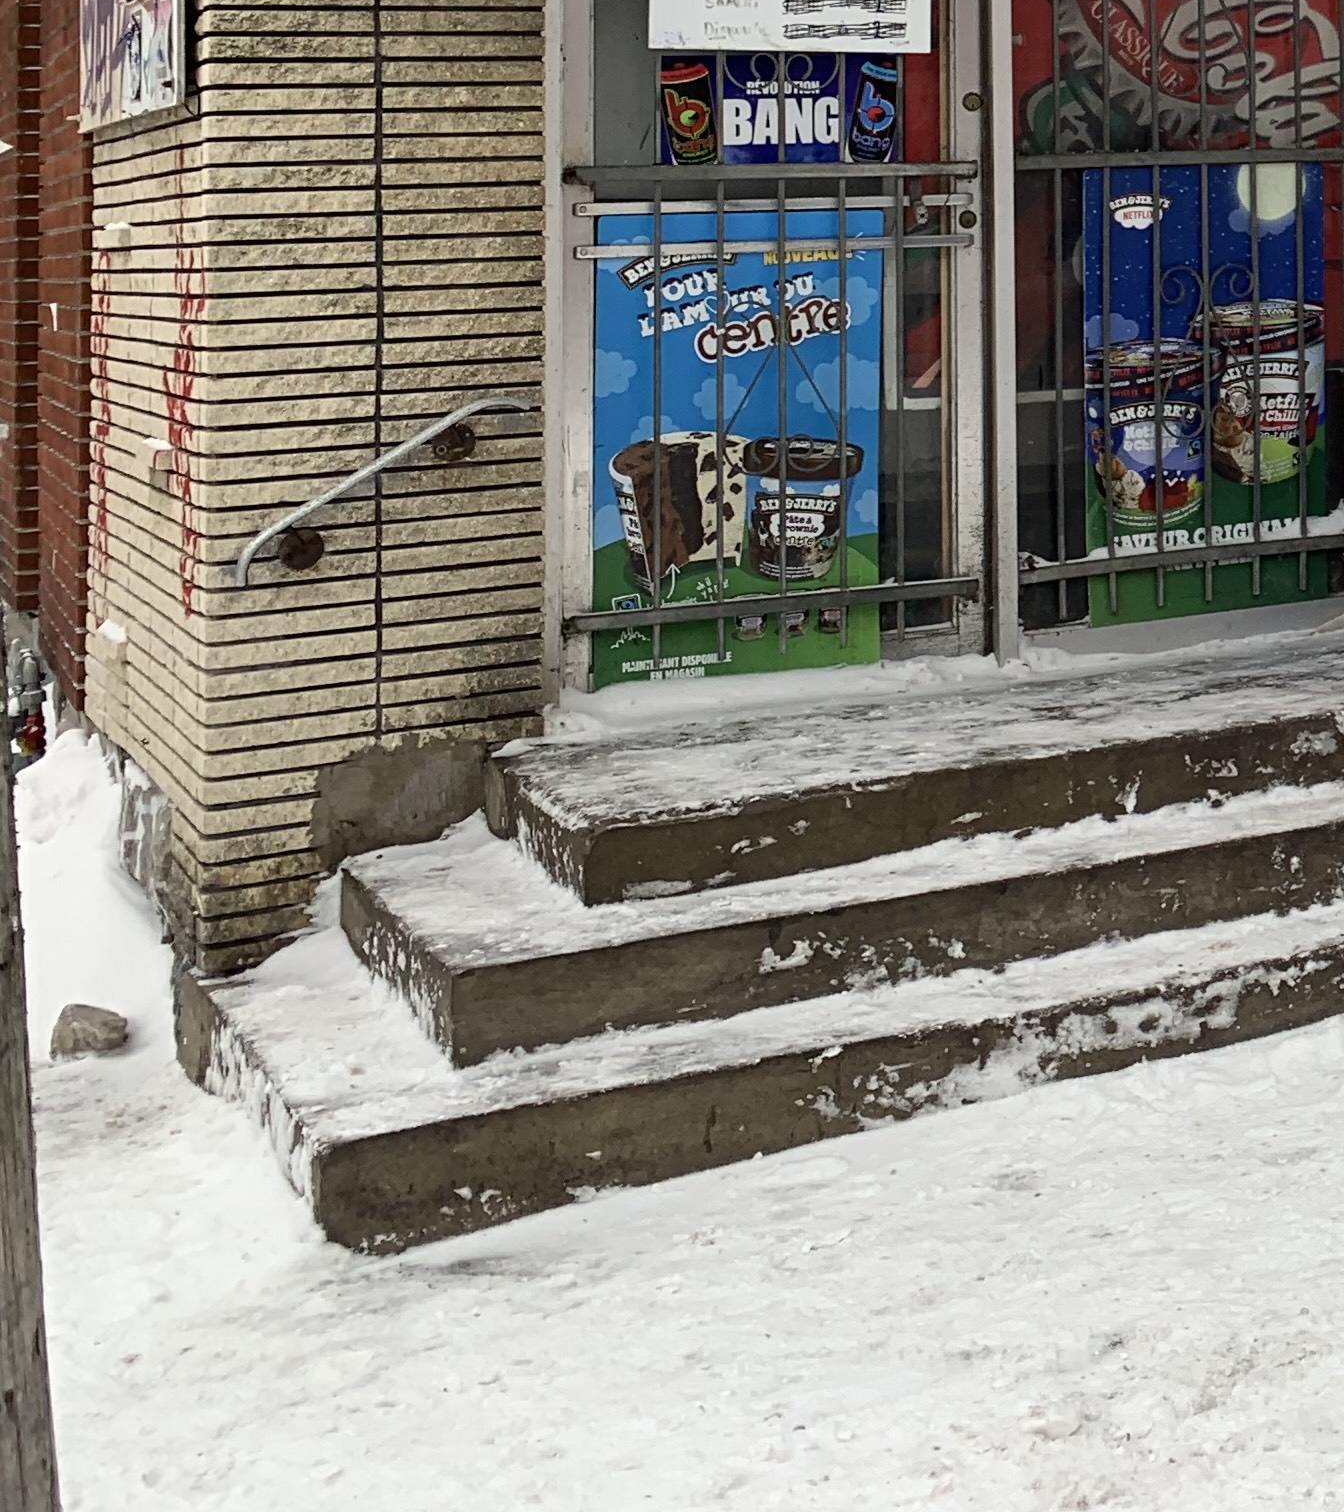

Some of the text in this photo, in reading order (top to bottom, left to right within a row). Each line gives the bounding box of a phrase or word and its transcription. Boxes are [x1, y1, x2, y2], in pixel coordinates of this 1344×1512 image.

[722, 97, 840, 145] BANG
[650, 666, 706, 680] EN MAGASIN
